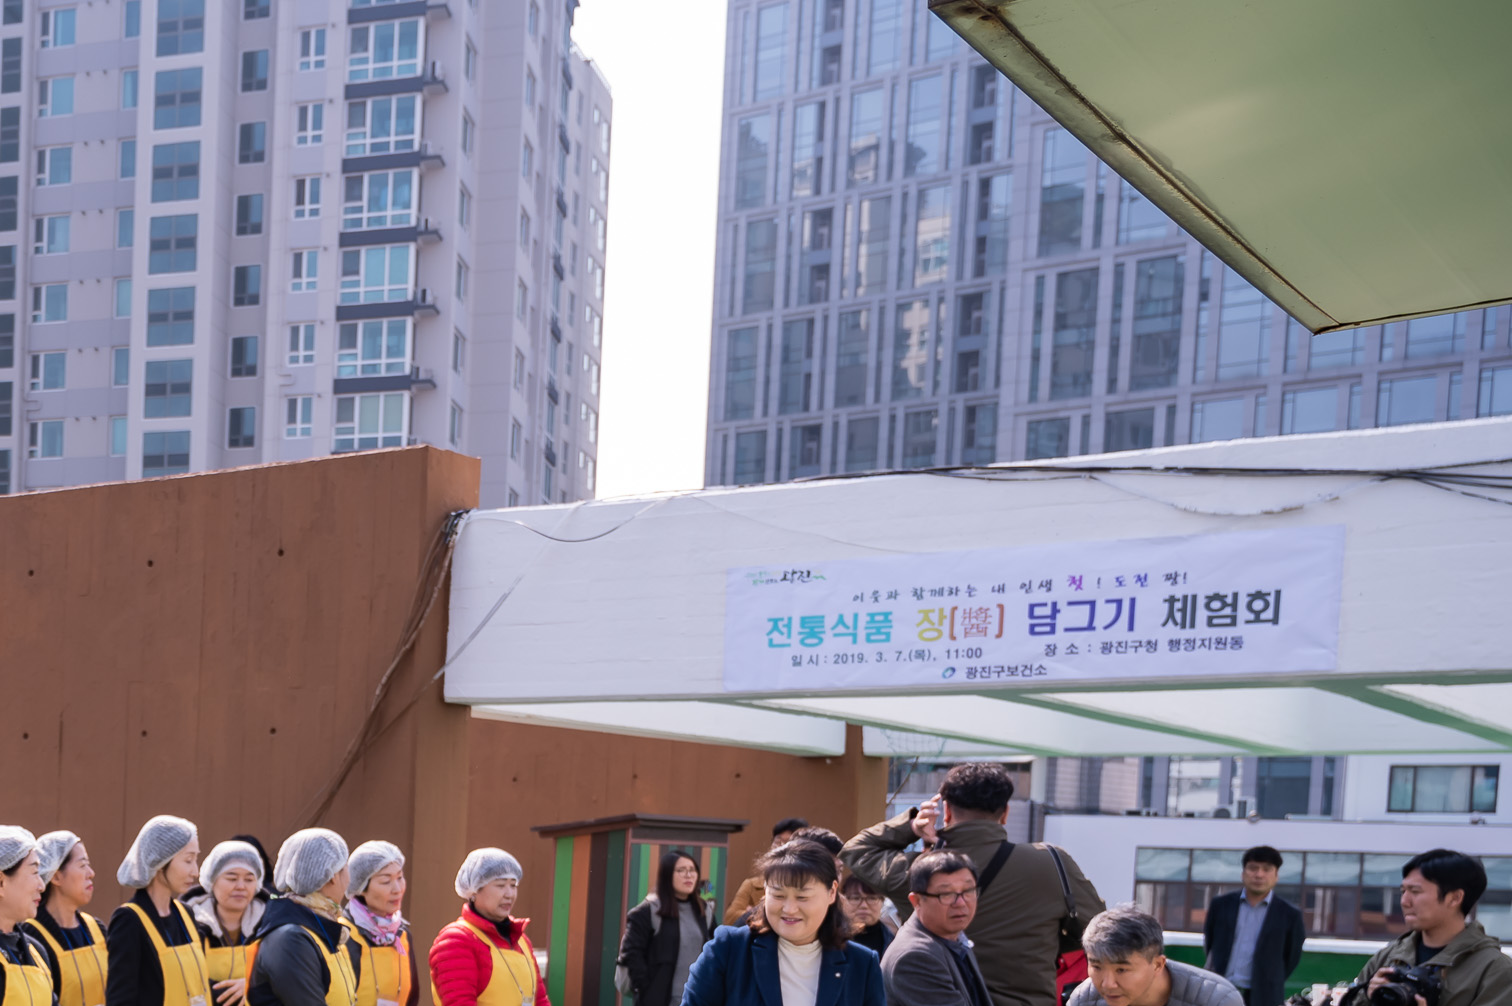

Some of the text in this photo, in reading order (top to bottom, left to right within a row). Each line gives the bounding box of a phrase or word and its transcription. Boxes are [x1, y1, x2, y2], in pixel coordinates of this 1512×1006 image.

[852, 589, 900, 603] 이웃과
[910, 584, 978, 601] 함께하는
[1018, 578, 1053, 594] 인생
[765, 611, 894, 649] 전통식품
[1027, 596, 1137, 637] 담그기
[1161, 589, 1282, 630] 체험회
[945, 647, 983, 660] 11:00
[1099, 638, 1159, 655] 광진구청
[965, 663, 1048, 680] 광진구보건소
